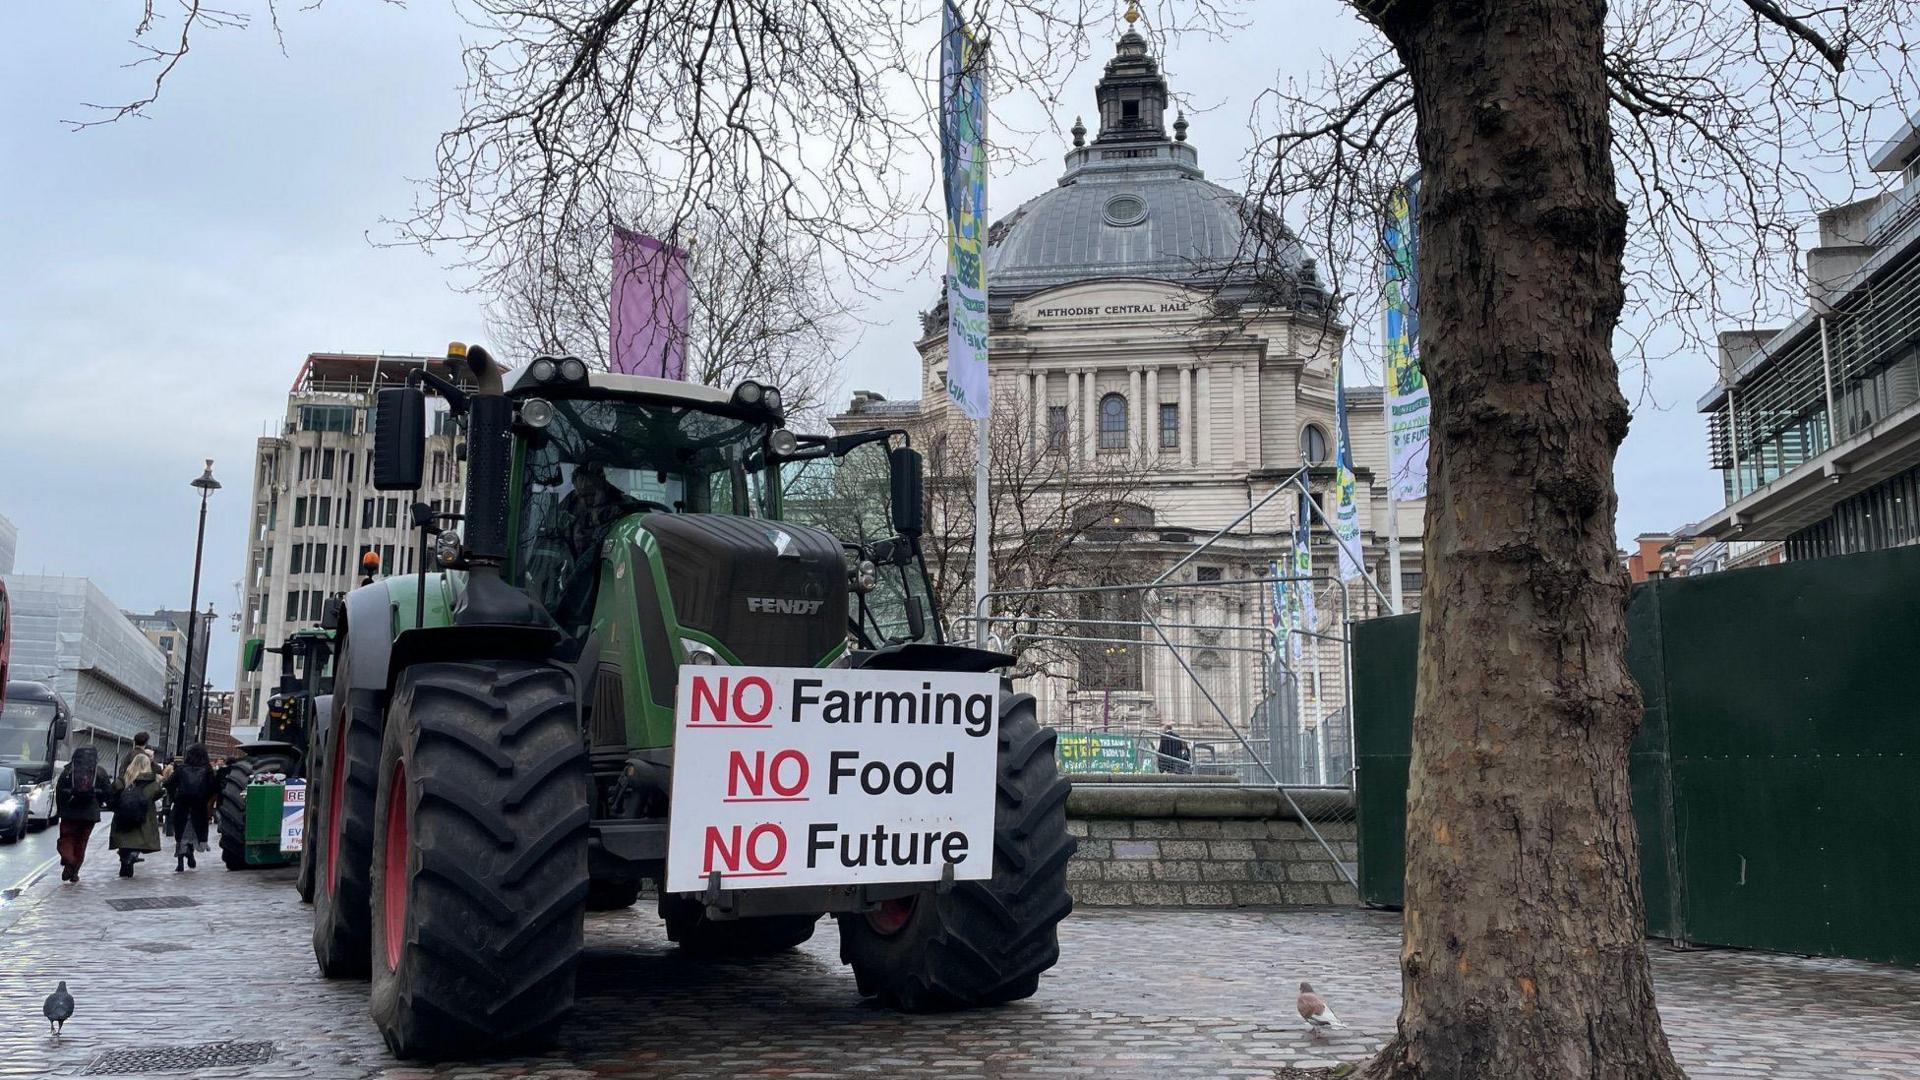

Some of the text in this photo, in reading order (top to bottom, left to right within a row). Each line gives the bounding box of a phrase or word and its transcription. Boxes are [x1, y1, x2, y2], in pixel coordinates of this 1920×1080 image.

[1037, 303, 1189, 317] METHODIST CENTRAL HALL
[747, 597, 824, 615] FENDT
[690, 675, 993, 737] NO Farming
[727, 749, 955, 797] NO Food
[703, 823, 969, 872] NO Future
